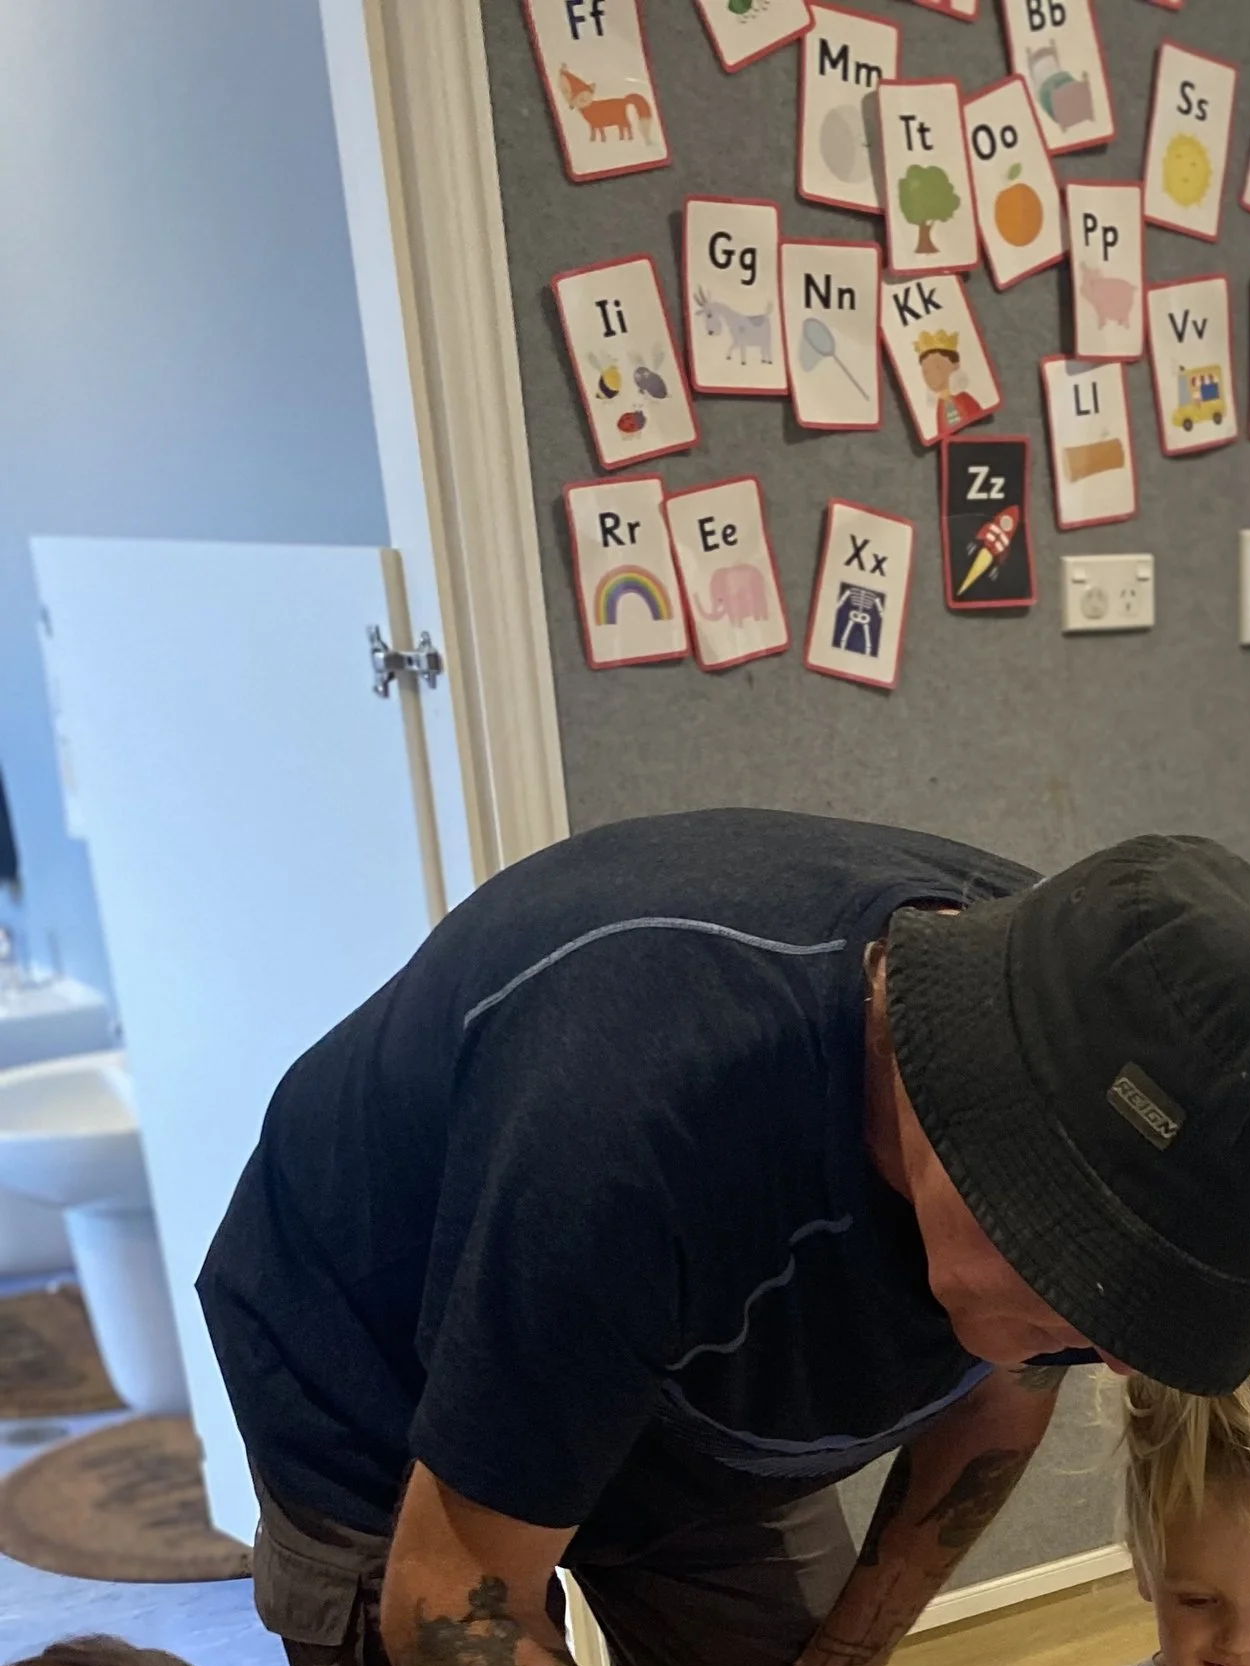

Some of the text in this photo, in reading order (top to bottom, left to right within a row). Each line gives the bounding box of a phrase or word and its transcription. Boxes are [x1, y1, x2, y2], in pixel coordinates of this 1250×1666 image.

[565, 0, 605, 40] Ff
[1026, 0, 1066, 31] Bb
[820, 38, 882, 87] Mm
[1177, 81, 1208, 121] Ss
[900, 115, 933, 150] Tt
[971, 124, 1018, 161] Oo
[1083, 213, 1118, 261] Pp
[709, 232, 756, 285] Gg
[805, 273, 855, 310] Nn
[892, 282, 943, 326] Kk
[596, 300, 627, 337] Ii
[1169, 310, 1207, 342] Vv
[967, 466, 1004, 499] Zz
[599, 512, 640, 547] Rr
[698, 517, 737, 552] Ee
[845, 535, 886, 576] Xx
